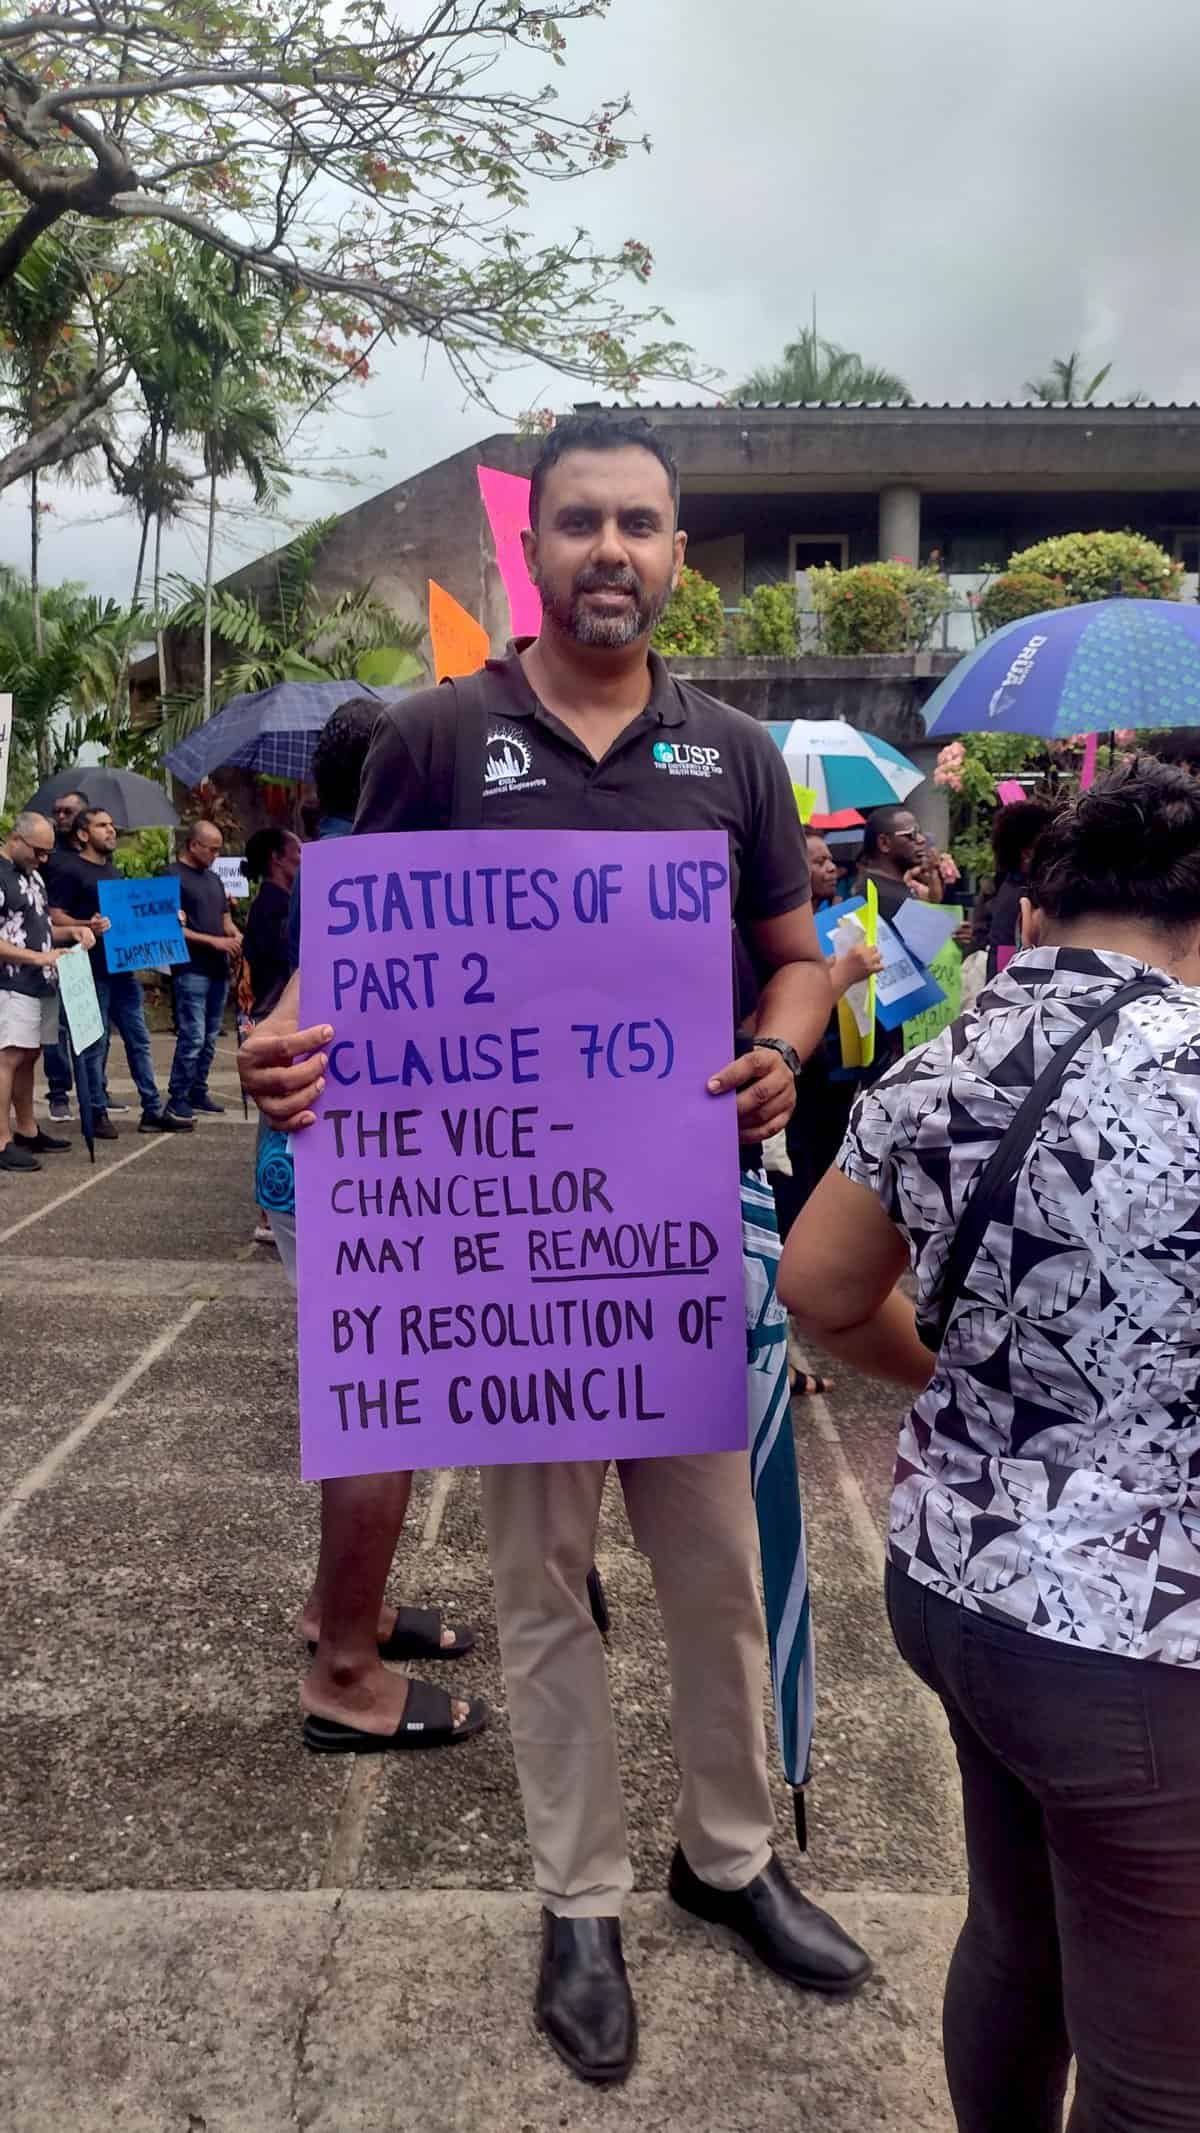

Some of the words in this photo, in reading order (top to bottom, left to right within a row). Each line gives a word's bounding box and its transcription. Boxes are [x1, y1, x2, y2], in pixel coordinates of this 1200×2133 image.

[1001, 635, 1048, 686] DRUA
[670, 743, 720, 766] USP
[327, 867, 560, 935] STATUTES
[573, 863, 623, 924] OF
[649, 860, 728, 923] USP
[333, 952, 440, 1012] PART
[462, 952, 496, 1005] 2
[328, 1027, 540, 1086] CLAUSE
[571, 1018, 675, 1080] 7(5)
[325, 1108, 422, 1158] THE
[331, 1168, 613, 1217] CHANCELLOR
[335, 1236, 424, 1275] MAY
[454, 1232, 504, 1274] BE
[528, 1221, 719, 1271] REMOVED
[332, 1304, 381, 1354] BY
[400, 1298, 654, 1355] RESOLUTION
[678, 1296, 728, 1350] OF
[329, 1378, 422, 1432] THE
[447, 1363, 666, 1426] COUNCIL
